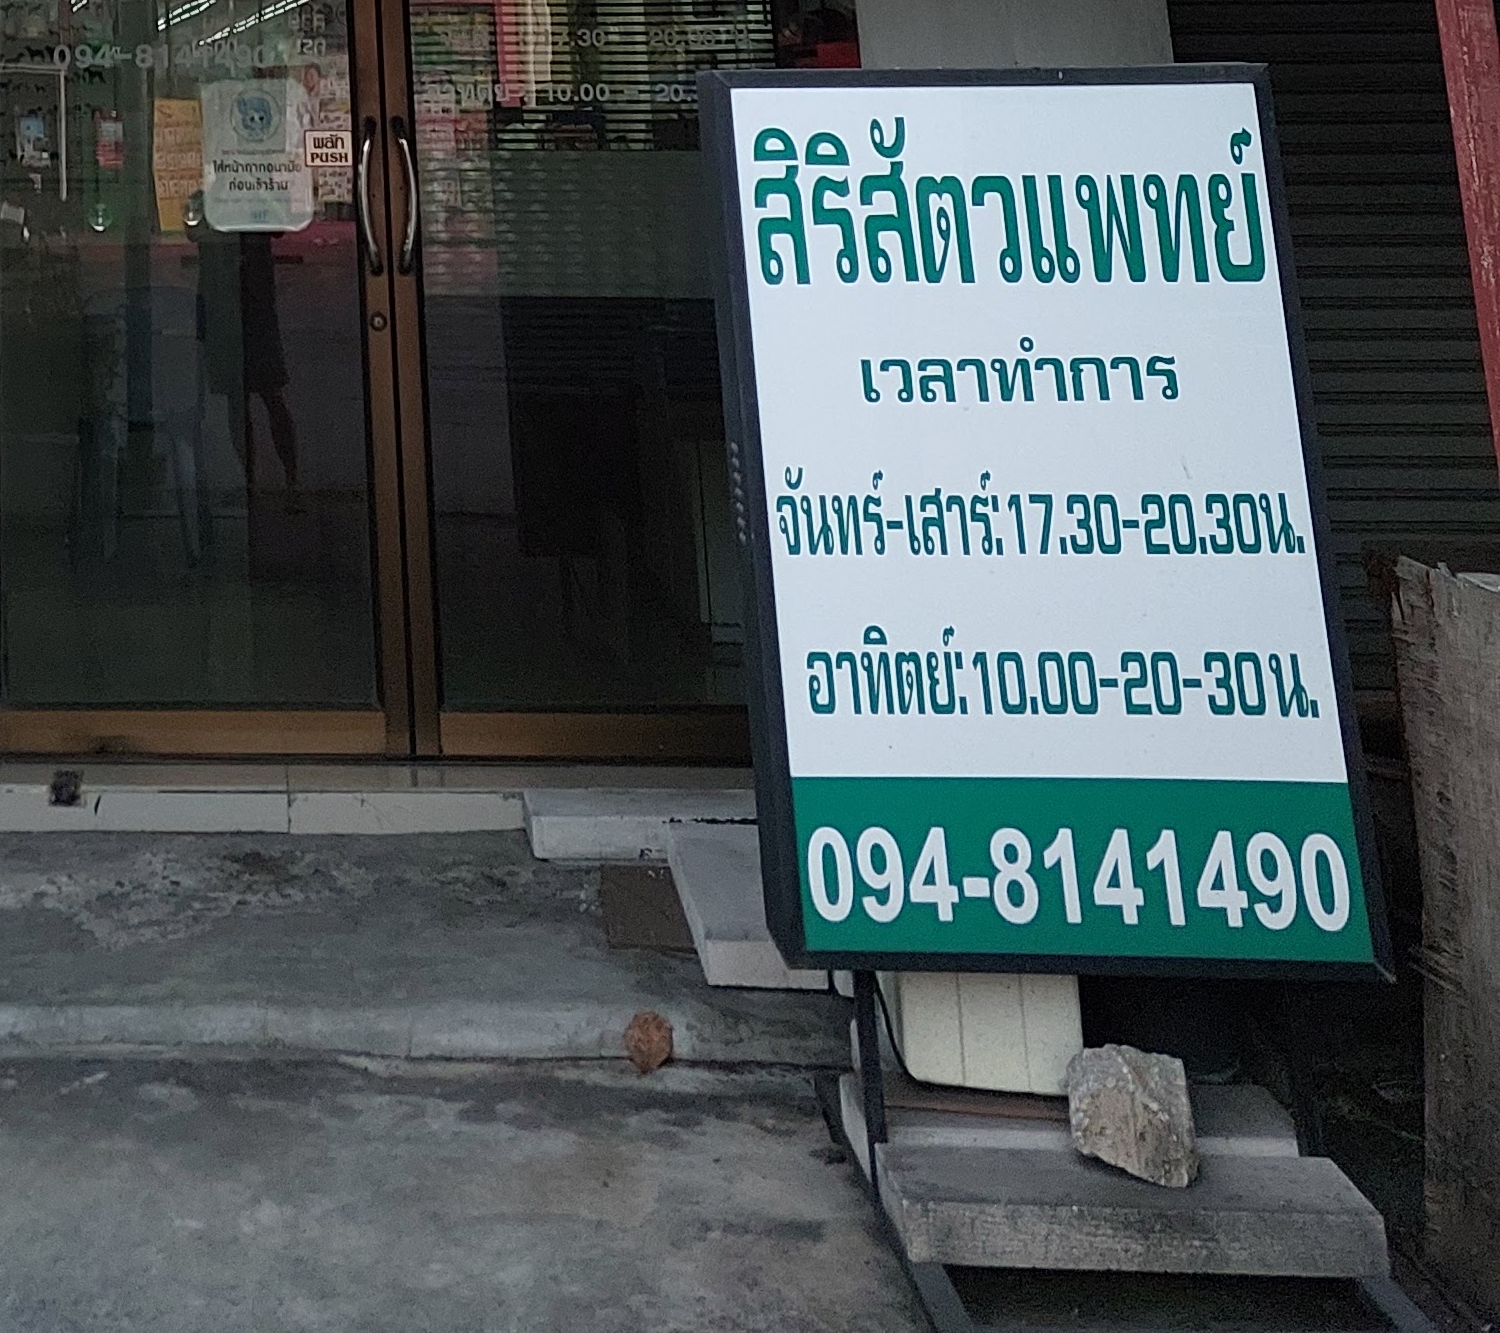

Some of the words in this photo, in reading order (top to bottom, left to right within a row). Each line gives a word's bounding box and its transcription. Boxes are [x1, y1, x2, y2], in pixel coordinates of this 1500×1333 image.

[310, 151, 349, 164] PUSH
[753, 116, 1268, 286] สิริสัตวแพทย์
[860, 336, 1181, 403] เวลาทำการ
[806, 825, 1350, 932] 094-8141490
